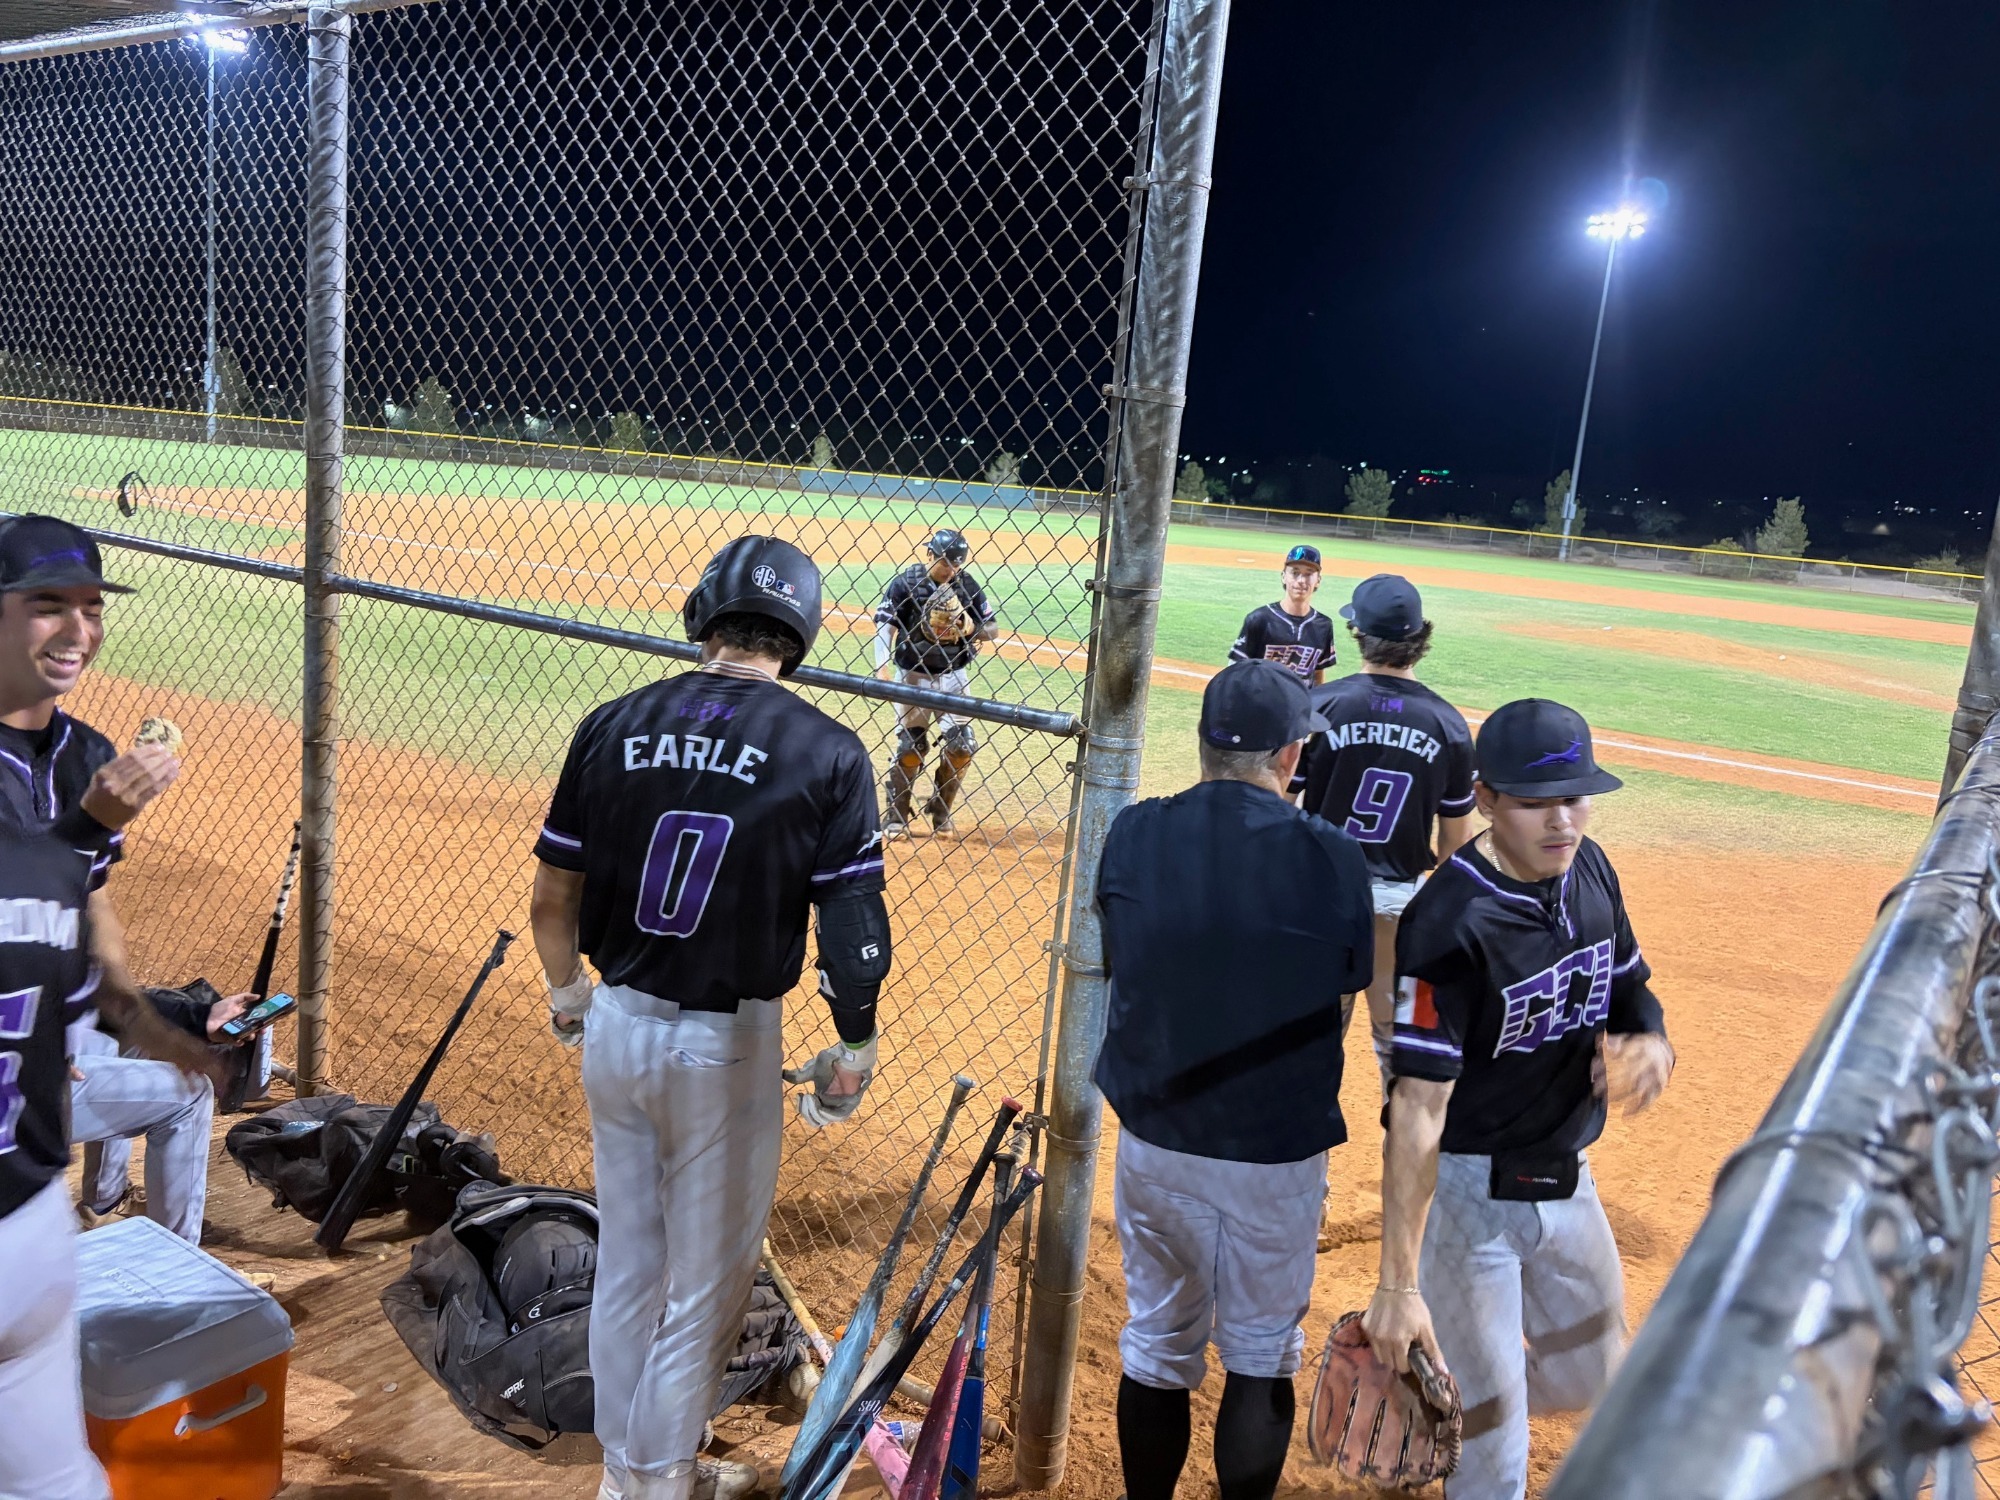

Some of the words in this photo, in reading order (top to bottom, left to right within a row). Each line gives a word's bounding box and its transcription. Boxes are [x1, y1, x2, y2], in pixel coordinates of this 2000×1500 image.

[623, 734, 769, 784] EARLE
[1325, 721, 1441, 764] MERCIER
[1344, 767, 1413, 844] 9
[635, 810, 735, 938] 0
